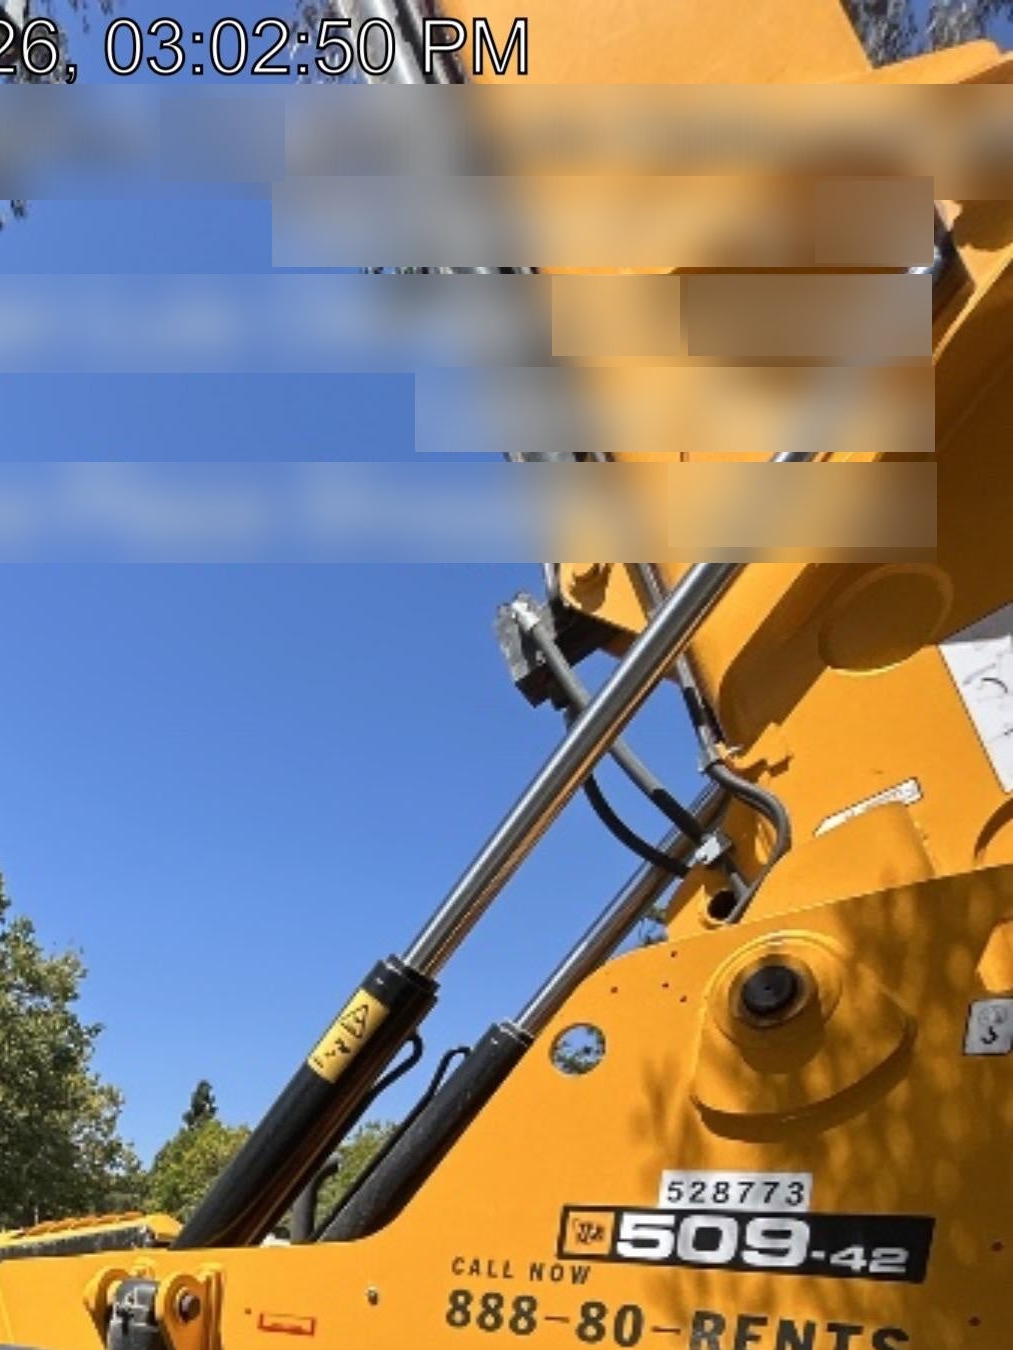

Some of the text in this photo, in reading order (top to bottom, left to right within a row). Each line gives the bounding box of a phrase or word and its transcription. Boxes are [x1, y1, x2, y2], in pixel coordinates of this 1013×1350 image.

[667, 1181, 805, 1206] 528773
[615, 1211, 910, 1274] 509-42
[451, 1256, 591, 1285] CALL NOW
